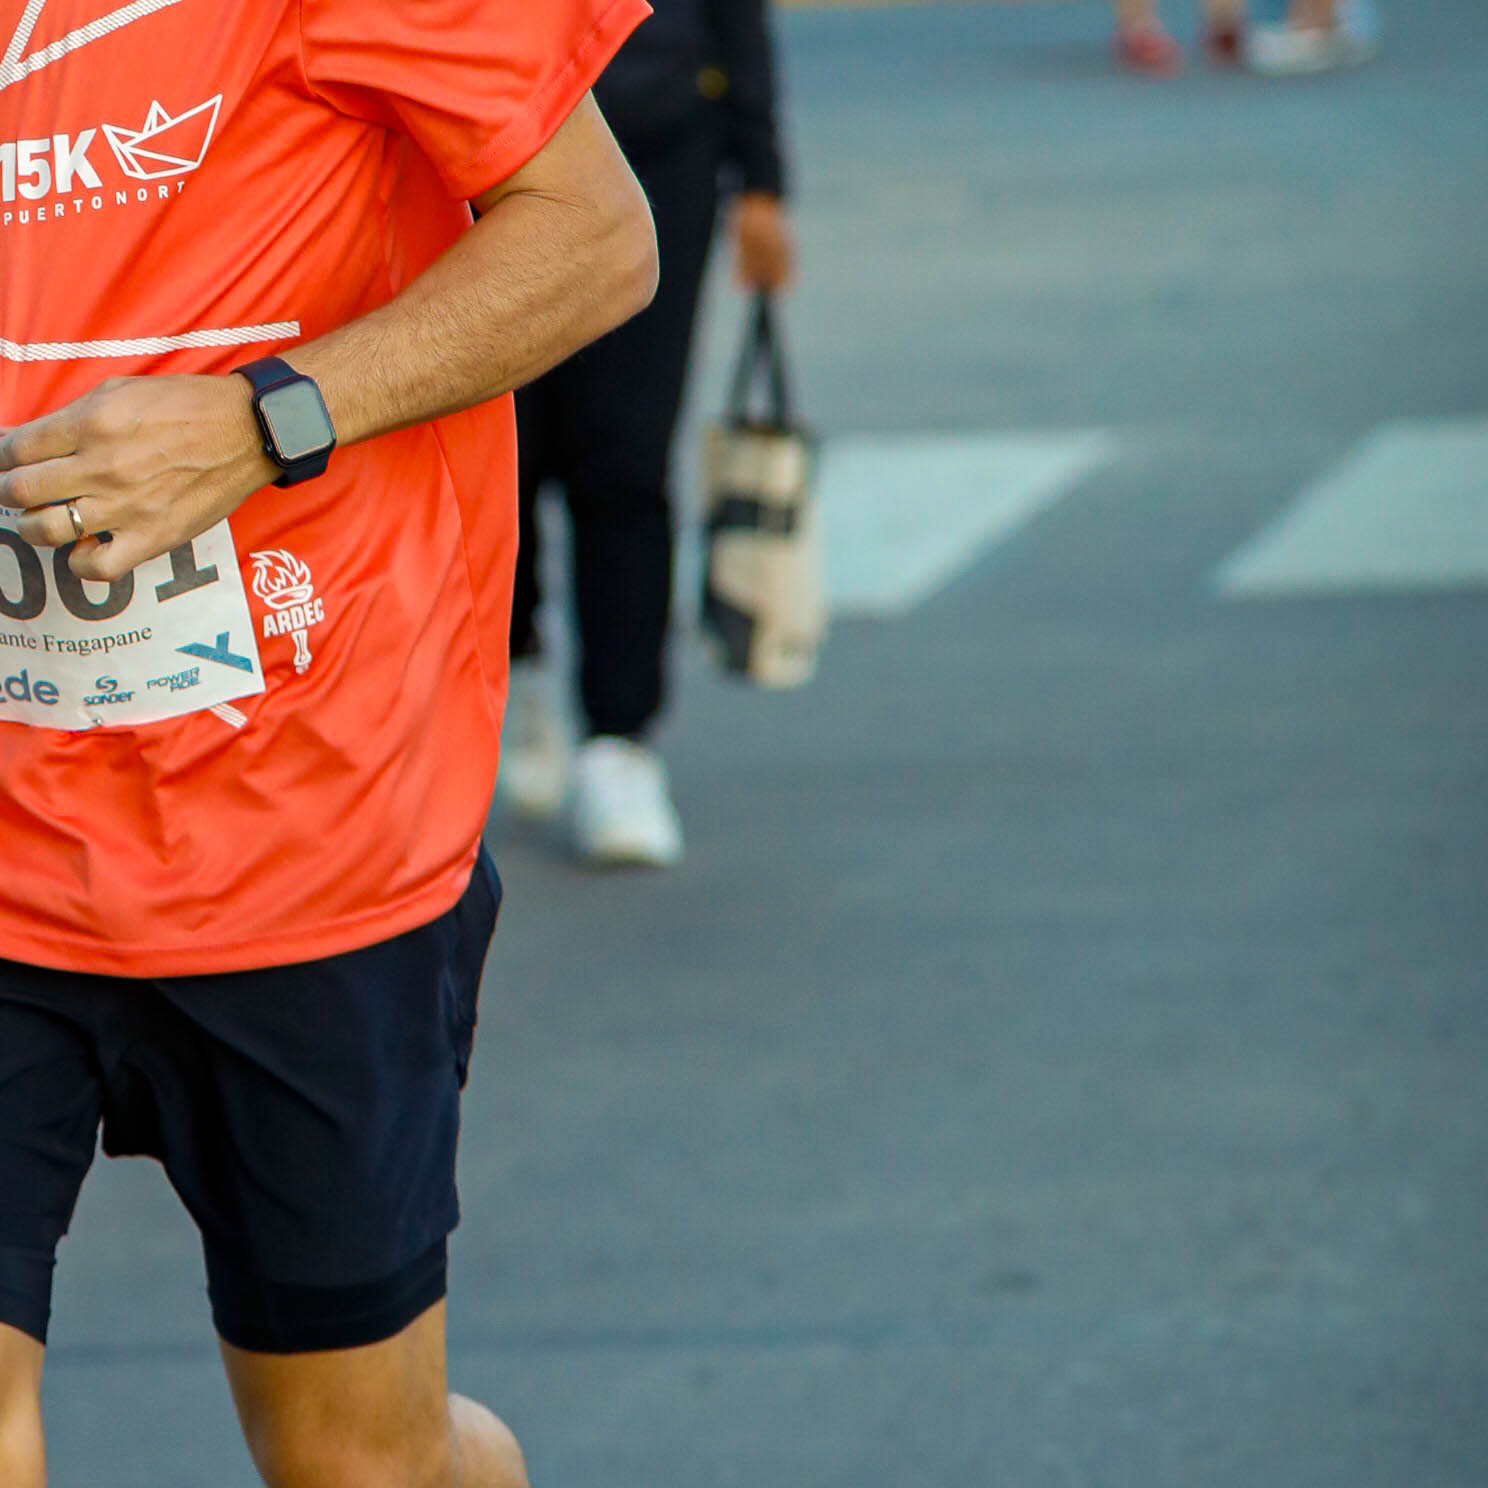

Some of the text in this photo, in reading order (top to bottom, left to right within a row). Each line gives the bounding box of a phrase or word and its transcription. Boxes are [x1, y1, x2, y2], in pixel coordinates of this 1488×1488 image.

[3, 180, 185, 227] PUERTO NORT
[263, 597, 325, 639] ARDEC
[43, 626, 153, 656] Fragapane
